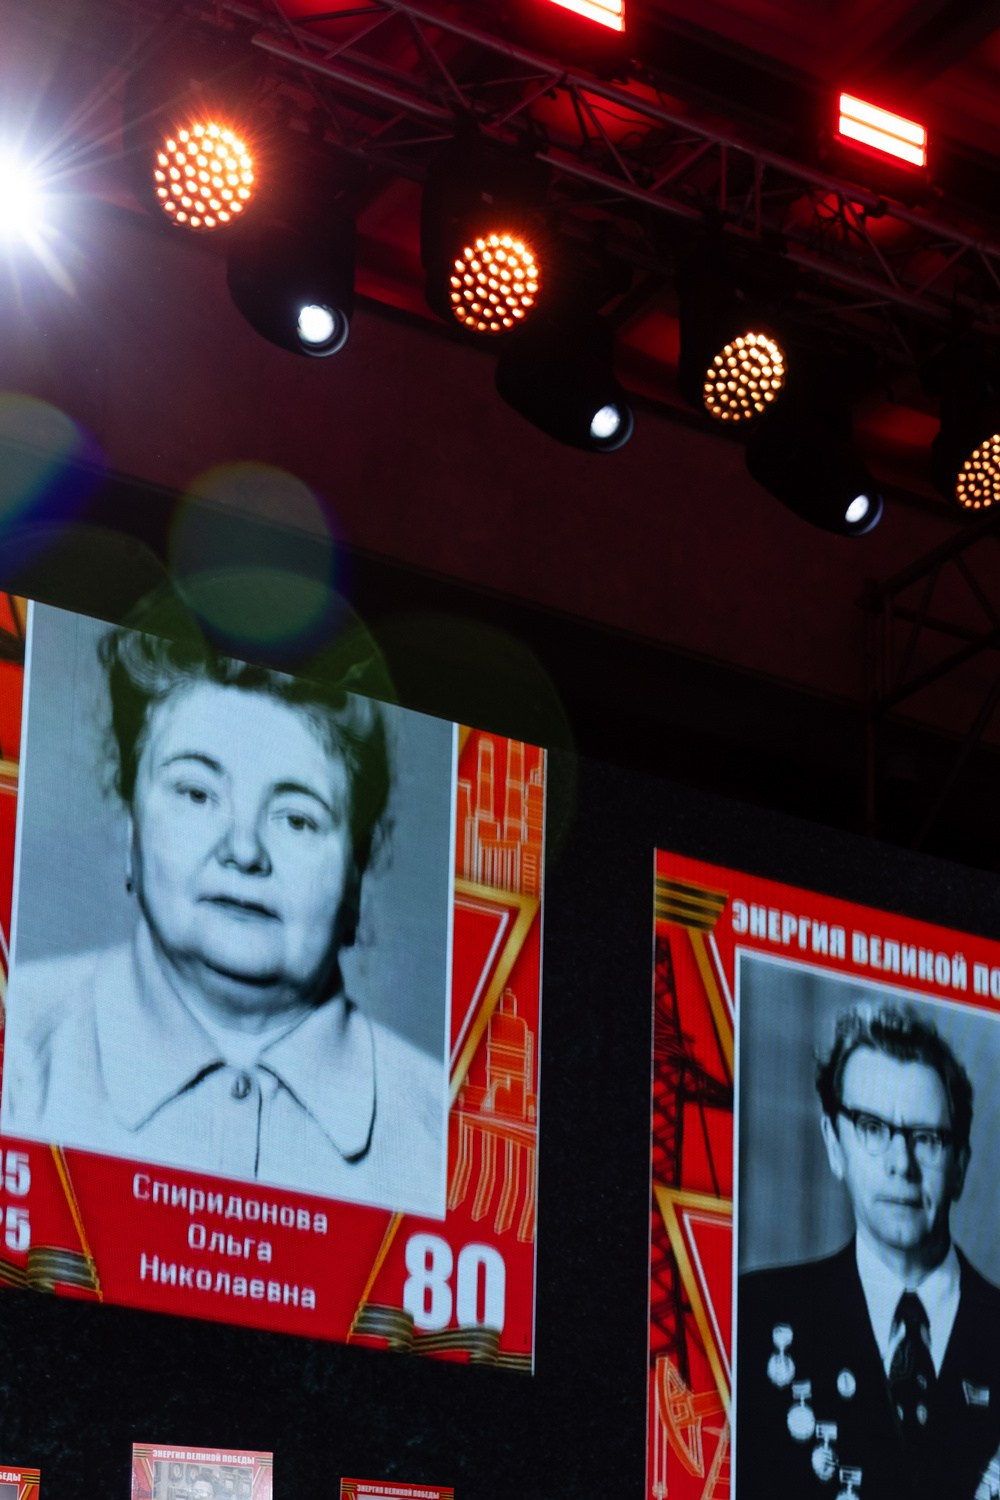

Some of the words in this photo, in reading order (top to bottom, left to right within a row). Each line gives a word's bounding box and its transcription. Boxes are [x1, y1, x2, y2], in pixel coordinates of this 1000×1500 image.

[732, 899, 845, 960] ЭНЕРГИЯ
[852, 930, 967, 991] ВЕЛИКОЙ
[133, 1173, 328, 1235] Спиридонова
[187, 1223, 273, 1264] Ольга
[139, 1252, 317, 1311] Николаевна
[403, 1231, 506, 1335] 80
[0, 1472, 21, 1482] БЕДЫ
[152, 1450, 186, 1460] ЭНЕРГИЯ
[187, 1452, 221, 1463] ВЕЛИКОЙ
[222, 1455, 255, 1465] ПОБЕДЫ
